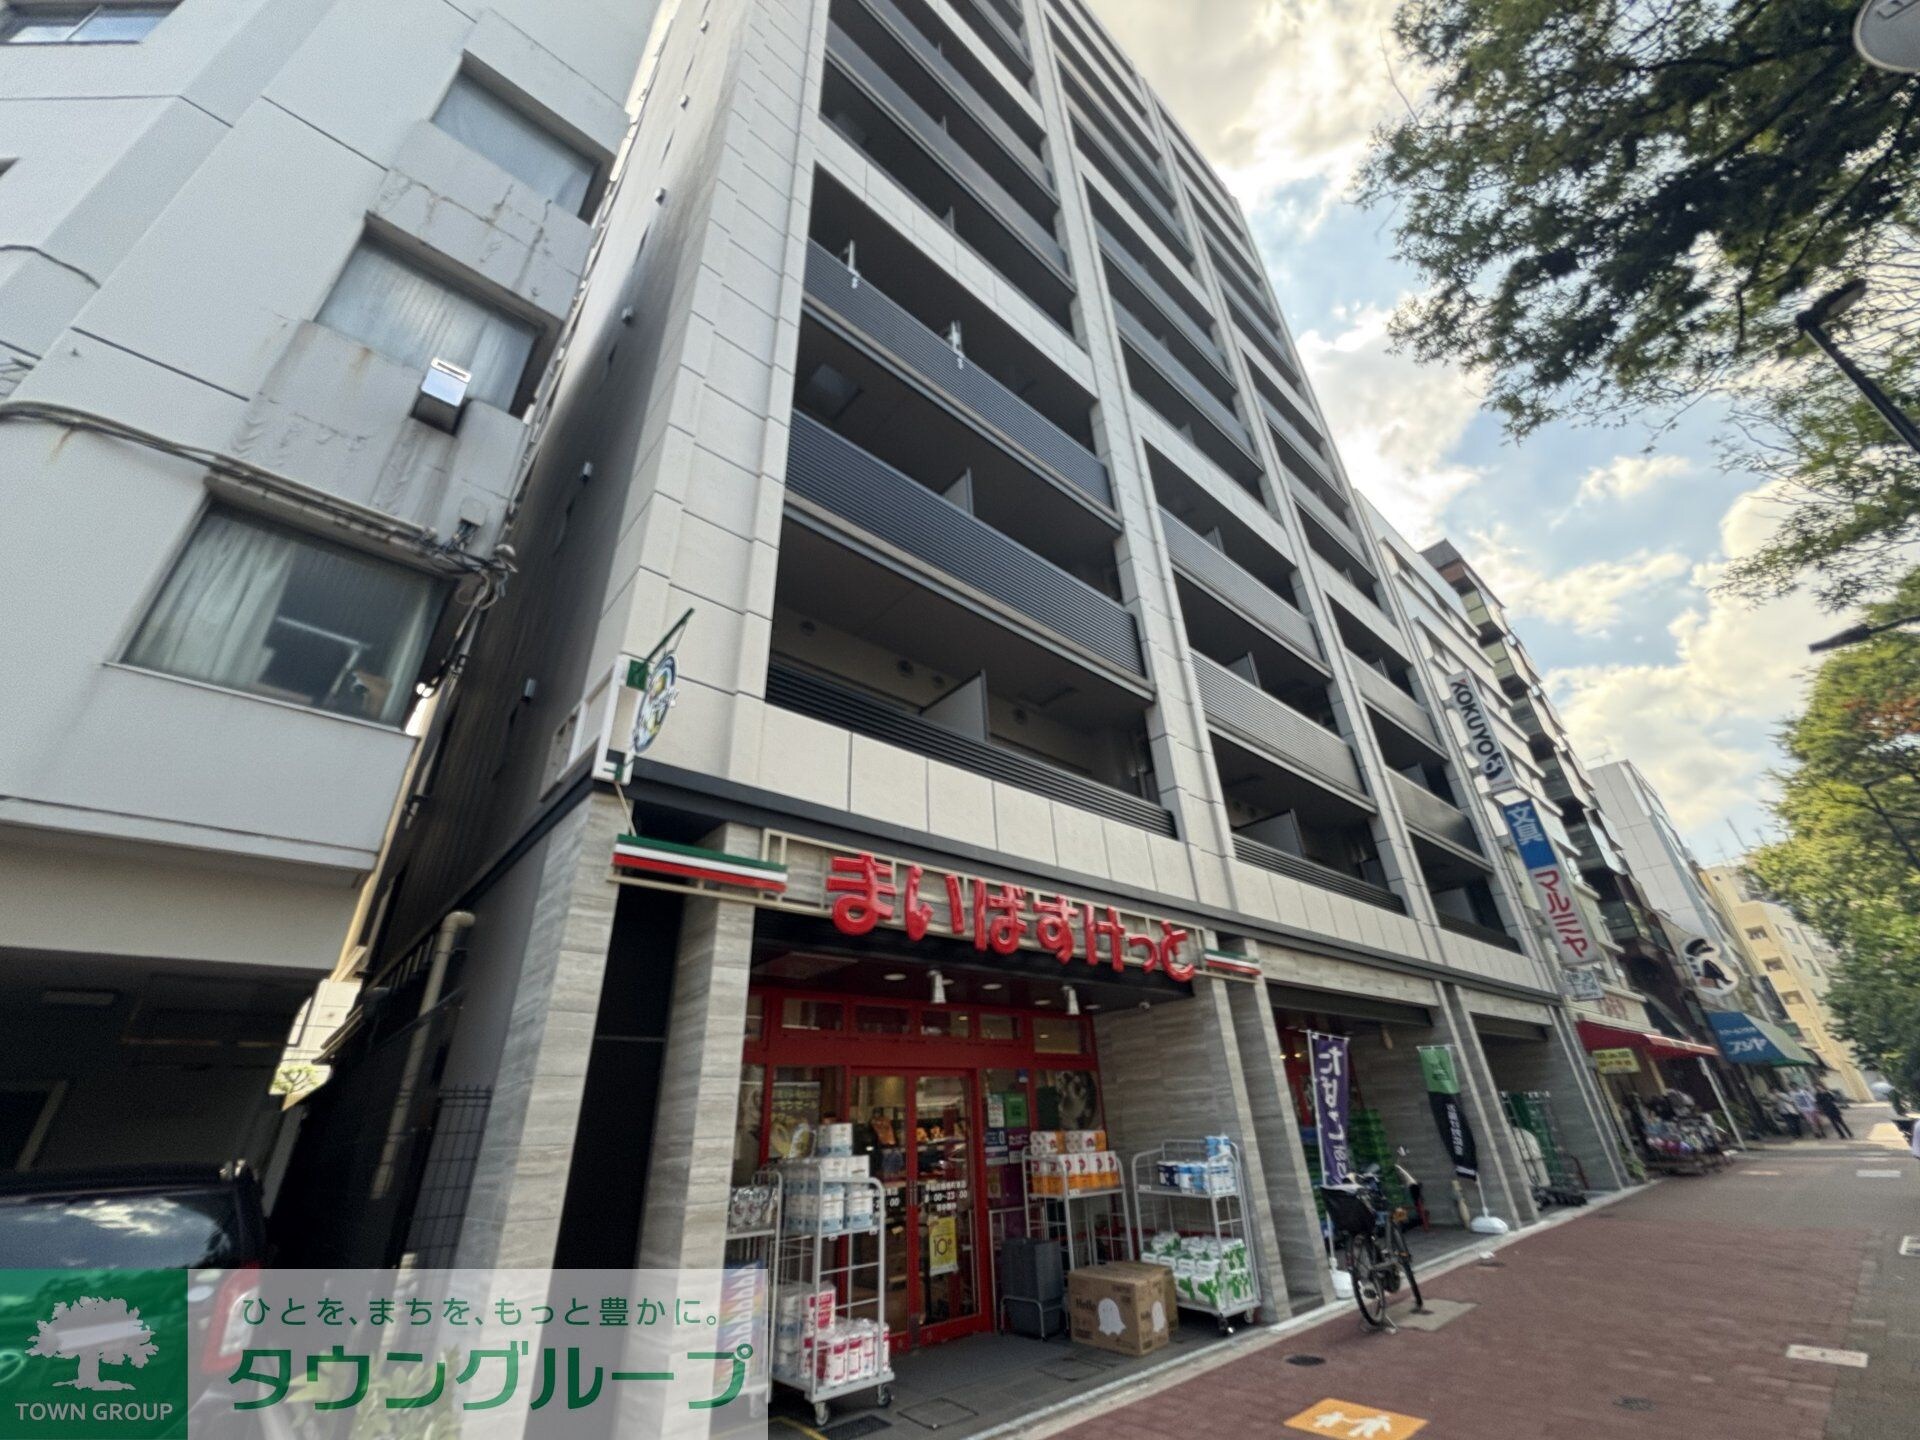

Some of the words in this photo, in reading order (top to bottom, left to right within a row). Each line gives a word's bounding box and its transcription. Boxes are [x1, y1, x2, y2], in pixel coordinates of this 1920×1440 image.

[1450, 680, 1495, 756] KOKUYO
[1506, 805, 1545, 847] 文具
[826, 851, 1195, 982] まいばすけっと
[1534, 869, 1588, 958] マルミヤ
